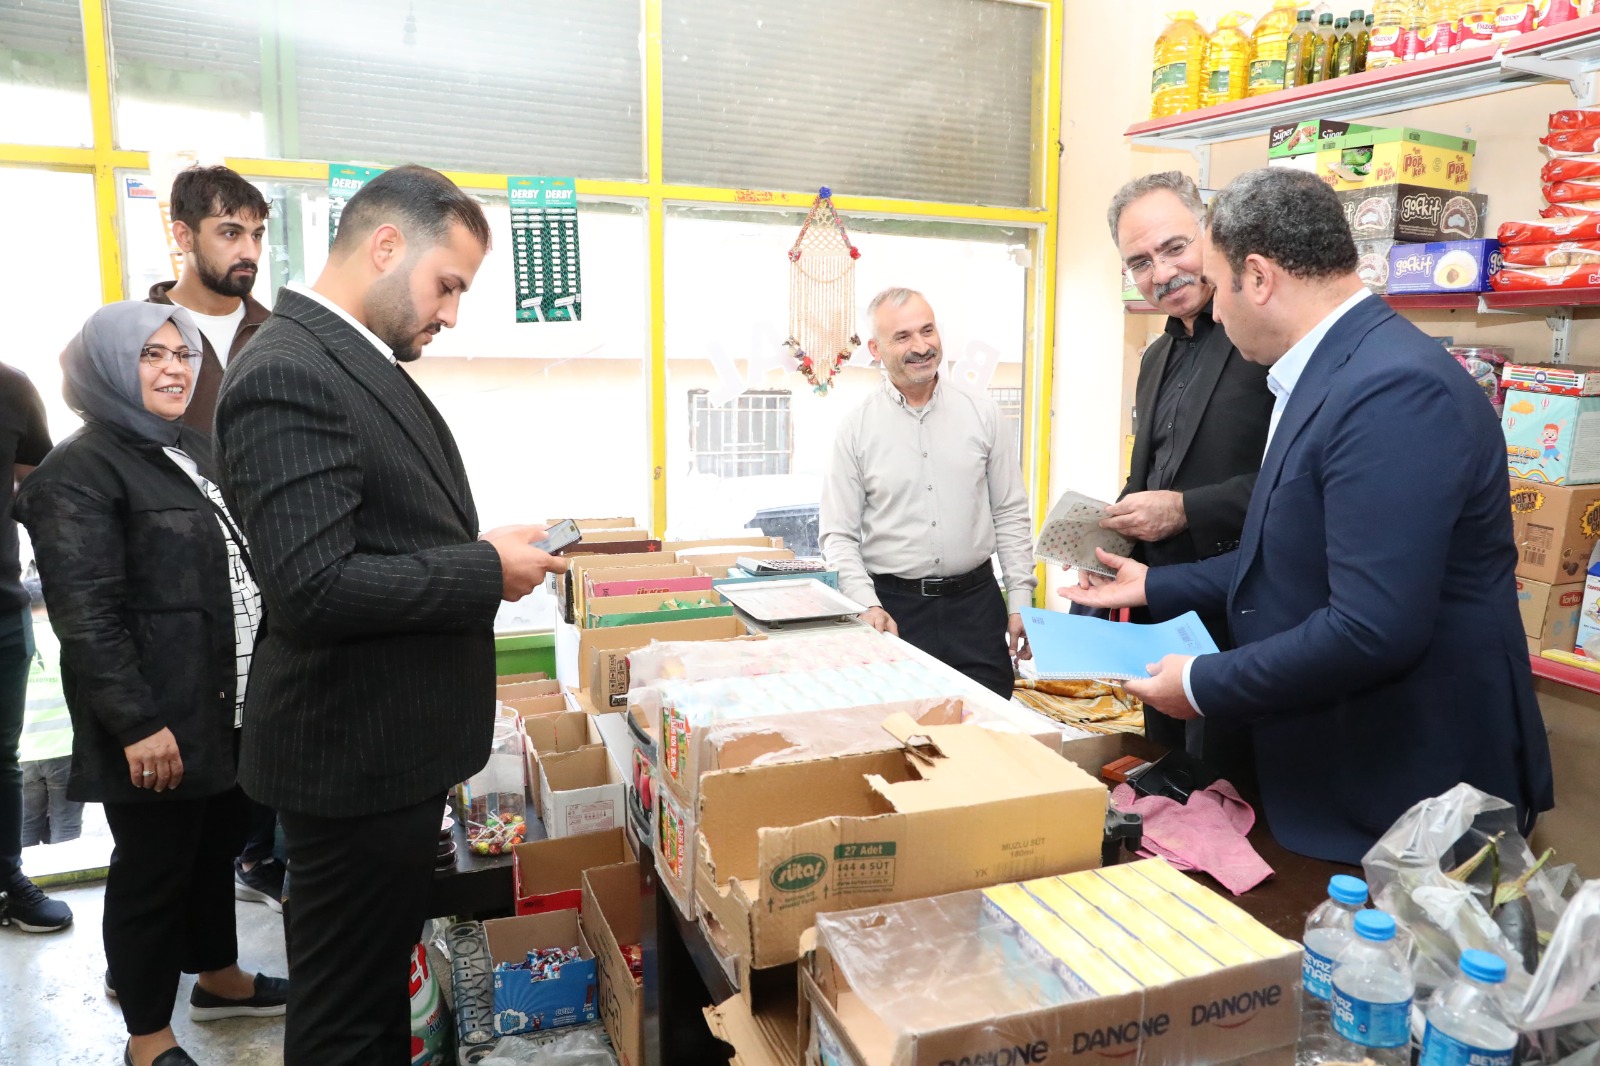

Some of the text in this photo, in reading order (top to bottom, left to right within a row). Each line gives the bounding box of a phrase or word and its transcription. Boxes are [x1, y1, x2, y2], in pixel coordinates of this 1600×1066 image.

[332, 177, 365, 189] DERBY
[511, 188, 540, 199] DERBY
[545, 189, 574, 200] DERBY
[844, 844, 883, 857] 27 Adet
[1001, 839, 1030, 852] MUZLU
[859, 861, 866, 871] 4
[869, 859, 890, 871] SÜT
[974, 867, 988, 878] YK
